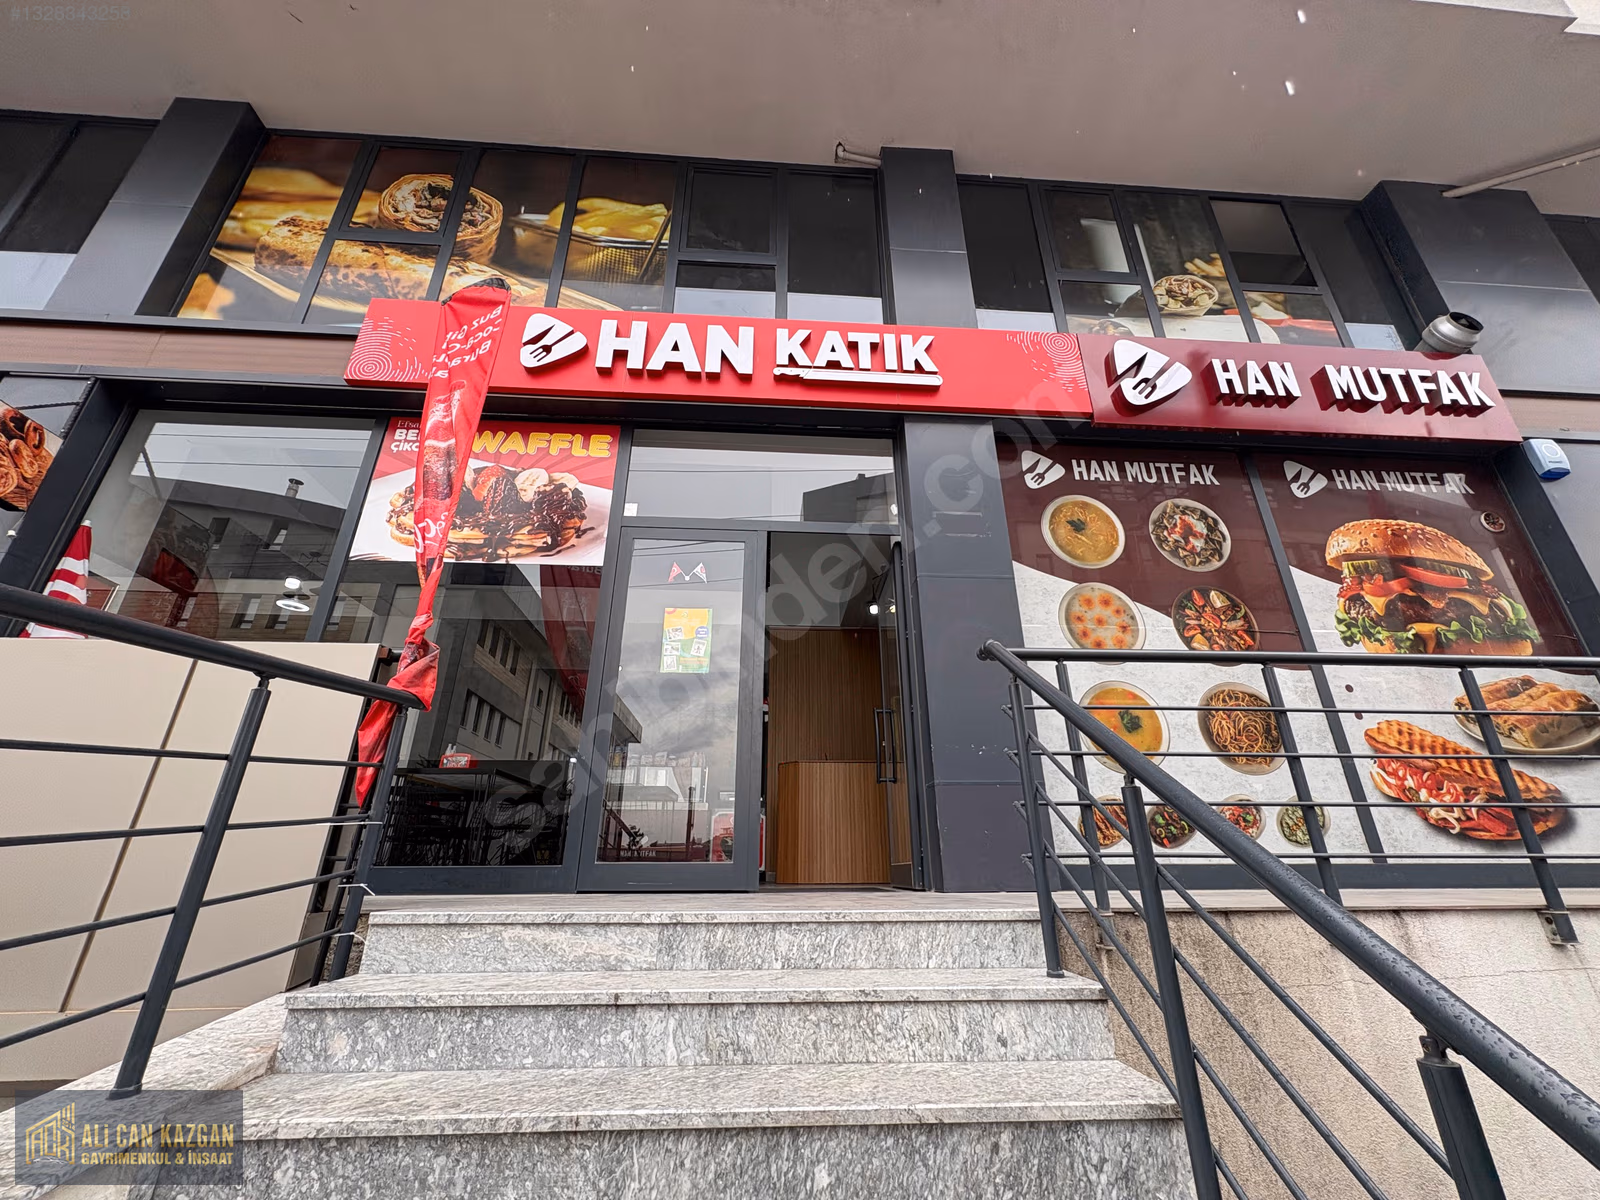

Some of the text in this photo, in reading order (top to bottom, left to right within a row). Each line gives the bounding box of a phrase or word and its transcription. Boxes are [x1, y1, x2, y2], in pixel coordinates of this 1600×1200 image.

[595, 319, 939, 375] HAN KATIK
[1211, 358, 1496, 408] HAN MUTFAK
[394, 429, 613, 458] BE WAFFLE
[1071, 459, 1220, 486] HAN MUTFAK
[1331, 469, 1475, 495] HAN MUTFAK
